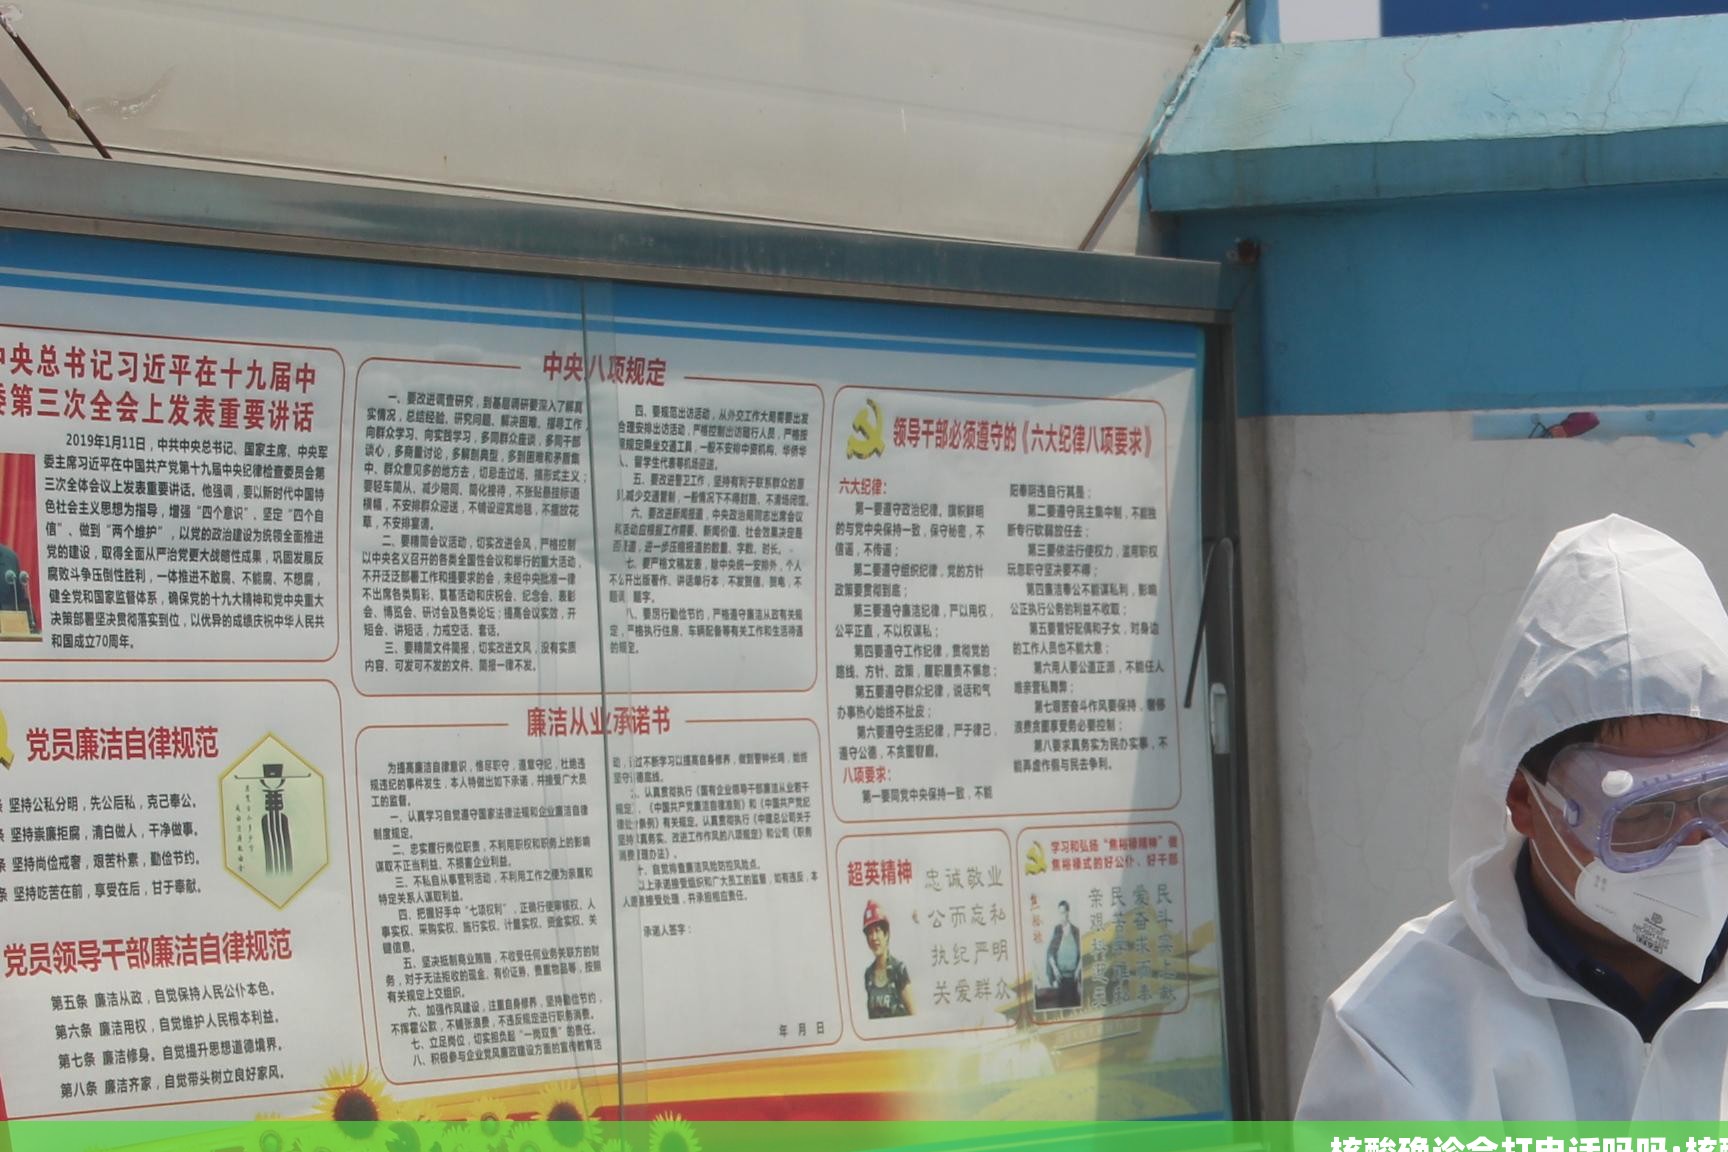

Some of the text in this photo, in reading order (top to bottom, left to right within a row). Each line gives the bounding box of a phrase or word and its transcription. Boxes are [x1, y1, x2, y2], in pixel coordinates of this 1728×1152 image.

[0, 342, 316, 394] 央总书记习近平在十九届中
[543, 350, 666, 387] 中央八项规定
[0, 384, 315, 433] 第三次全会上发表重要讲话
[52, 633, 135, 649] 和国成立70周年。
[27, 726, 219, 760] 党员廉洁自律规范
[4, 928, 292, 977] 党员领导干部廉洁自律规范
[51, 993, 88, 1010] 第五条
[55, 1022, 92, 1039] 第六条
[59, 1052, 96, 1069] 第七条
[61, 1080, 97, 1098] 第八条
